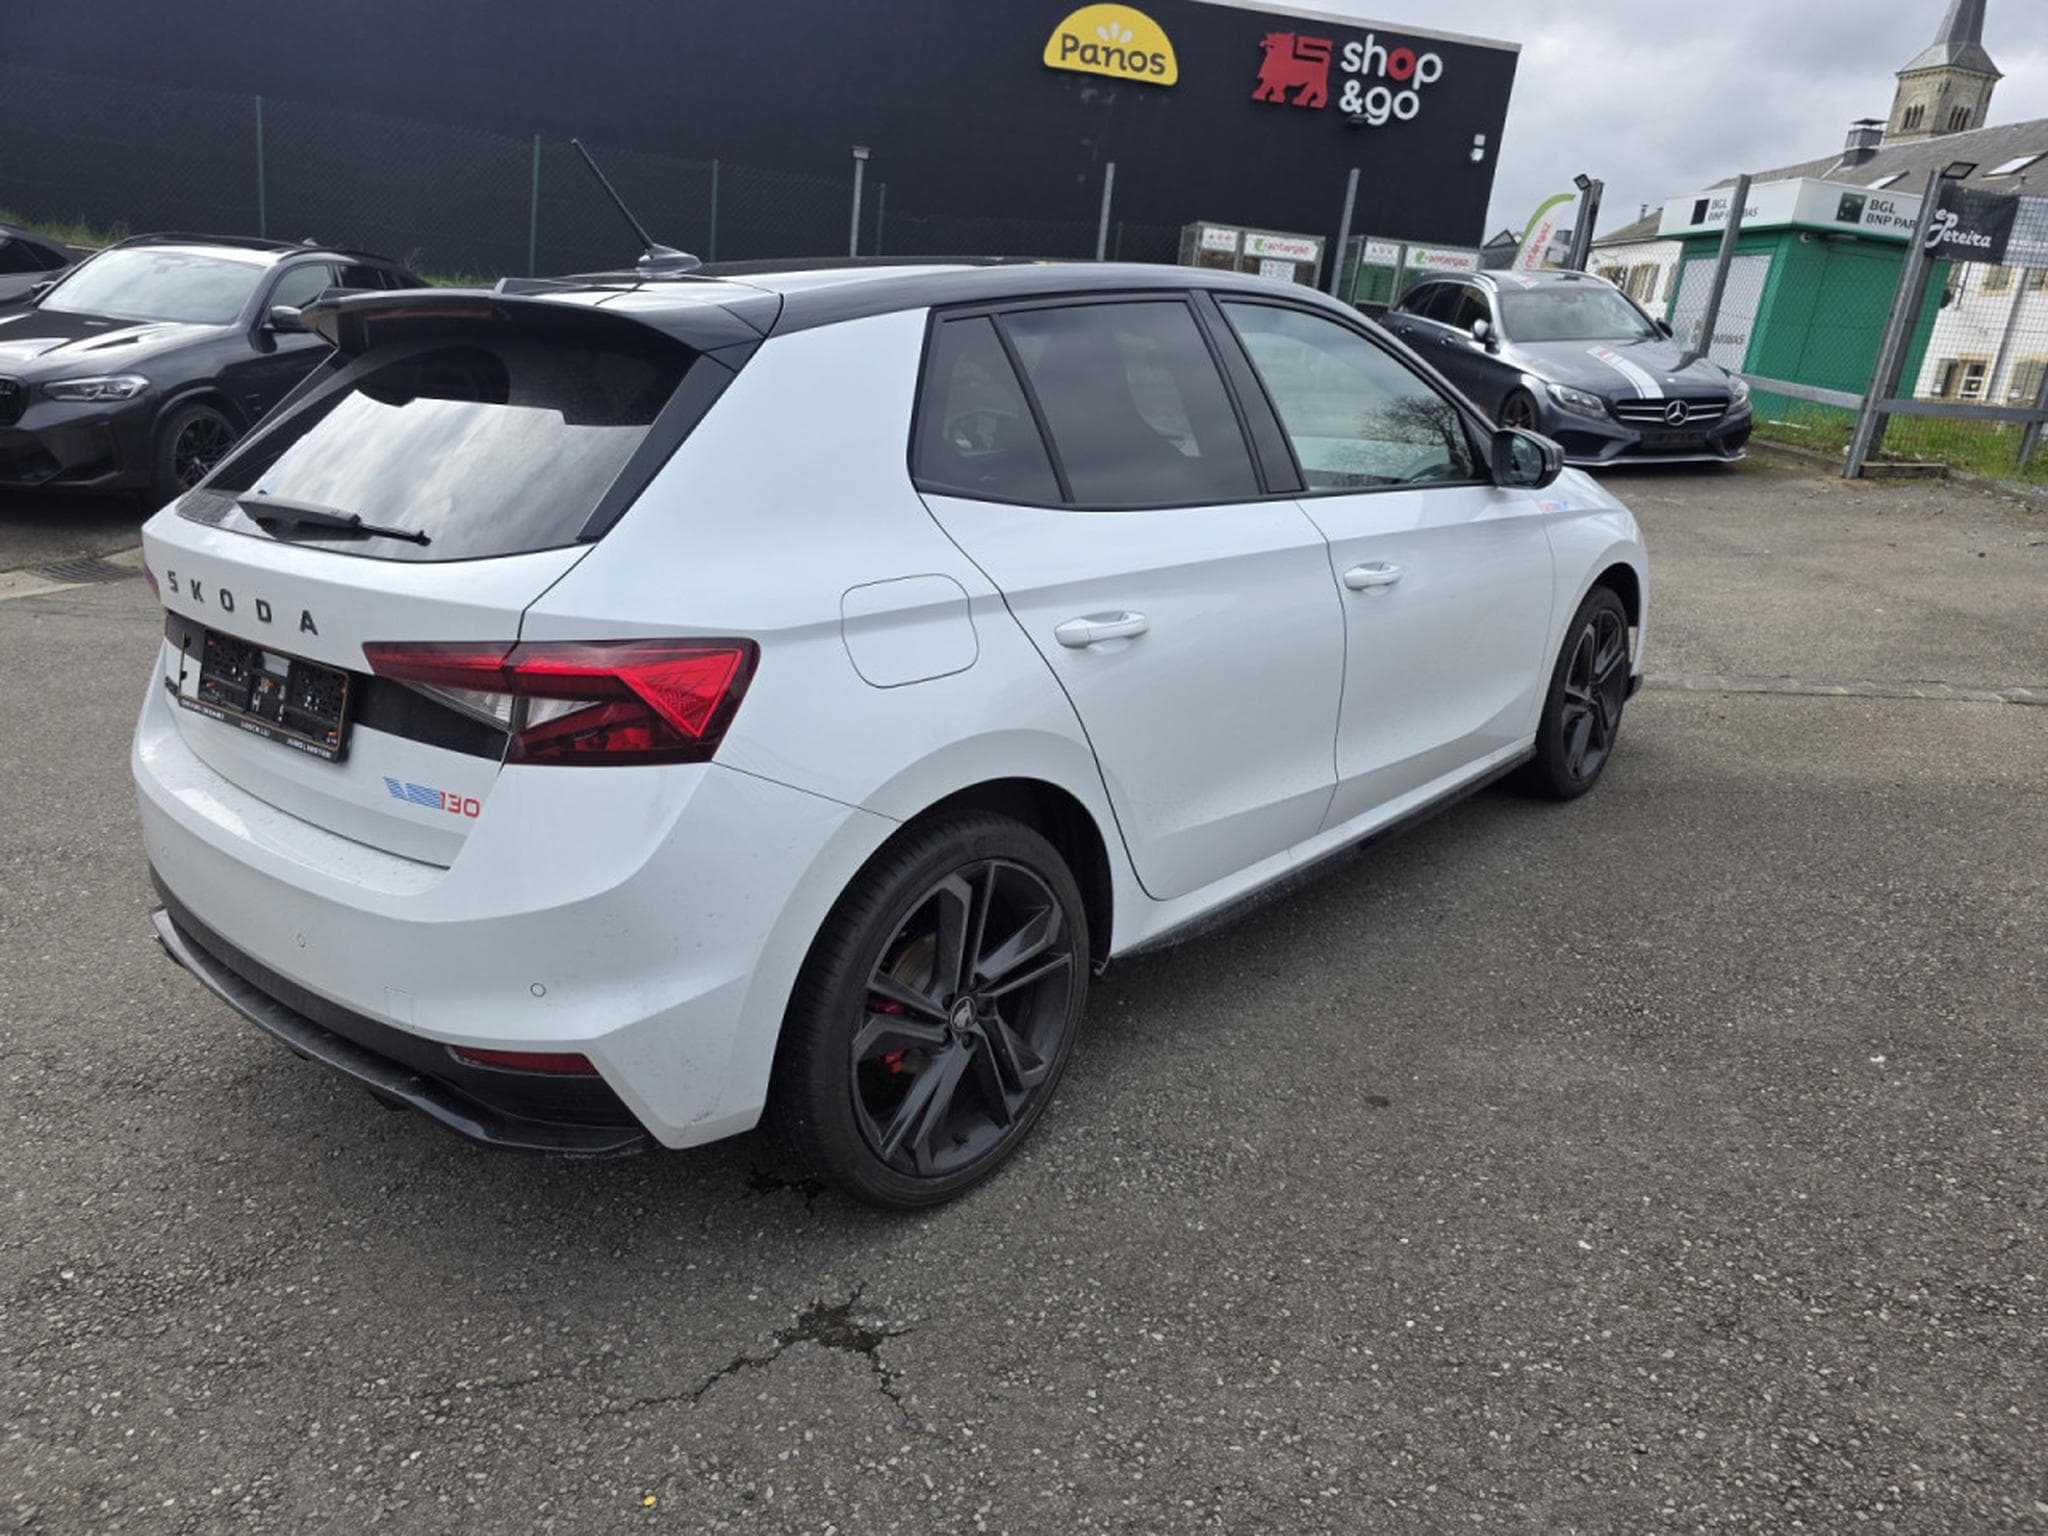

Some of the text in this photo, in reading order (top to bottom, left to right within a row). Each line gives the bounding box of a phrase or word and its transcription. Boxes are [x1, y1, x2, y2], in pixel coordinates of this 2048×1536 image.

[1059, 33, 1166, 76] Panos
[1340, 33, 1443, 91] shop
[1339, 79, 1420, 126] &go
[1866, 212, 1893, 226] BNP
[1869, 199, 1896, 215] BGL
[1924, 213, 1992, 249] Pereira
[439, 790, 481, 818] 130
